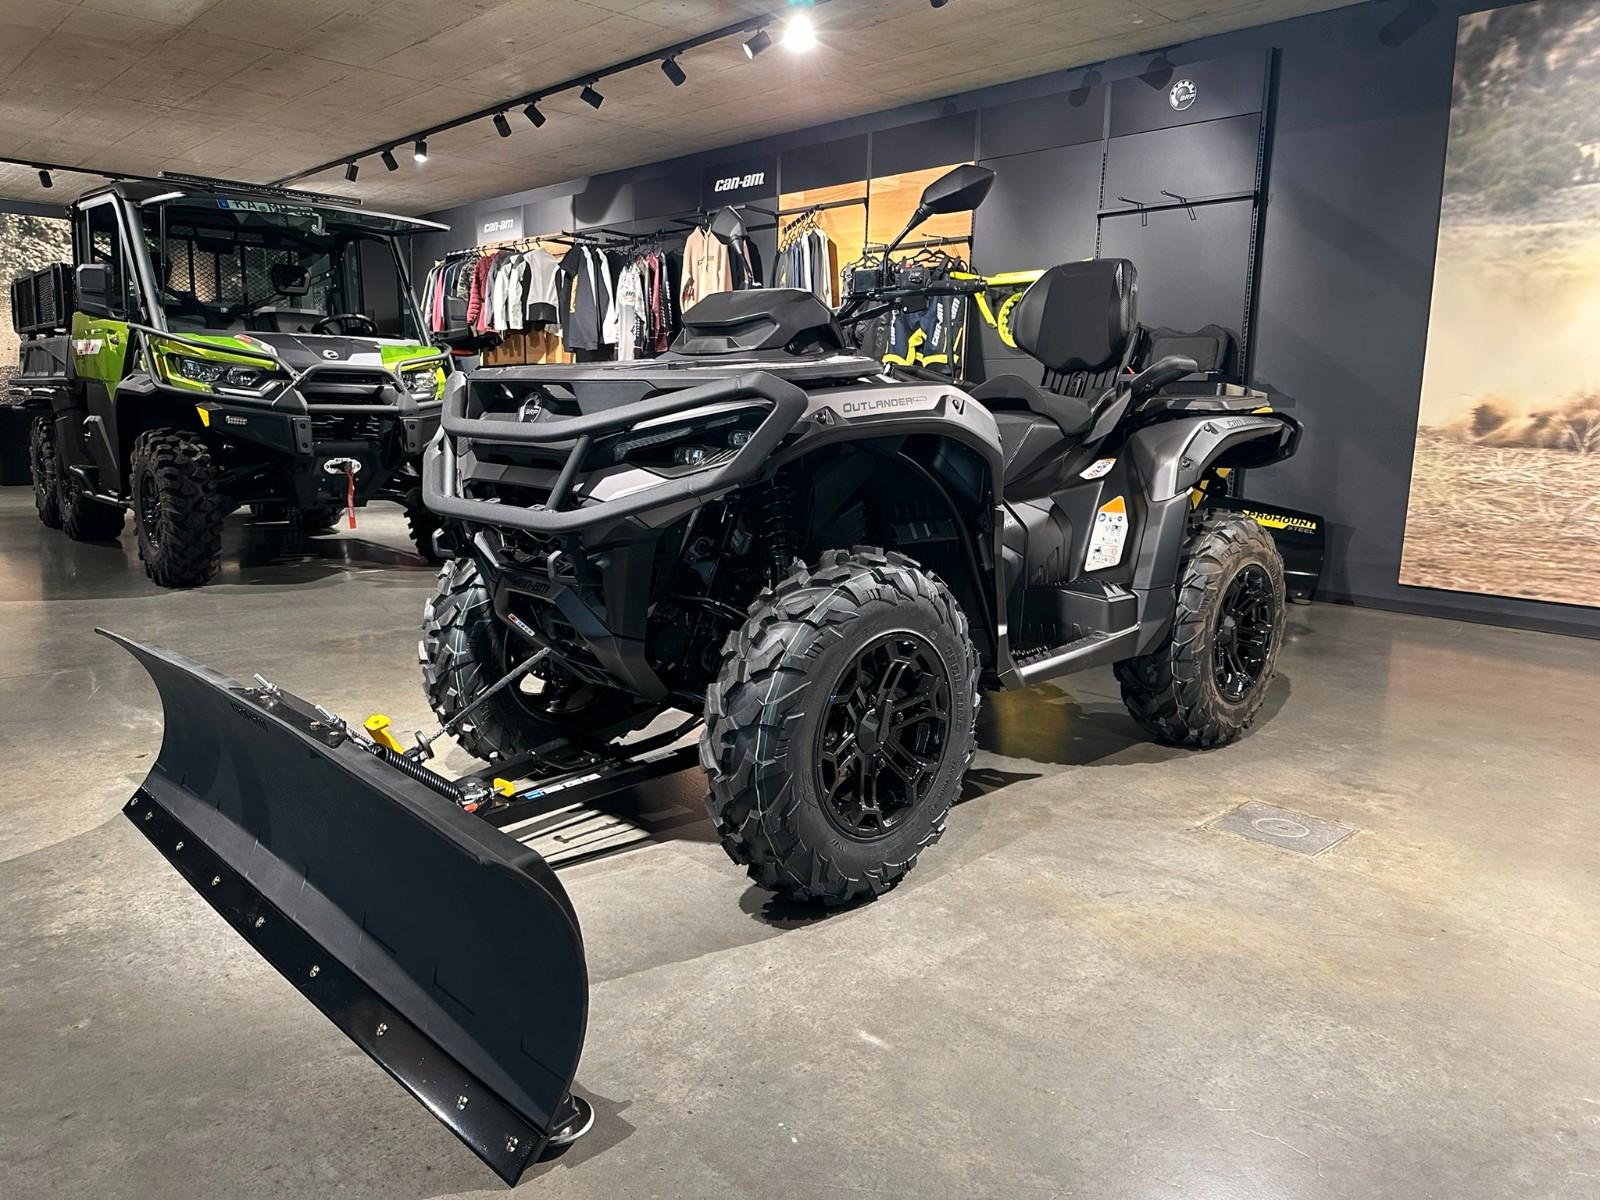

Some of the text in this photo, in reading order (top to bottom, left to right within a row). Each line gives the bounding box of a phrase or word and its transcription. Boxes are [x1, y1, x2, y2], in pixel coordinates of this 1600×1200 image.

[714, 172, 765, 192] can-am
[484, 219, 514, 233] can-am
[931, 302, 944, 347] can-am
[842, 397, 913, 413] OUTLANDER
